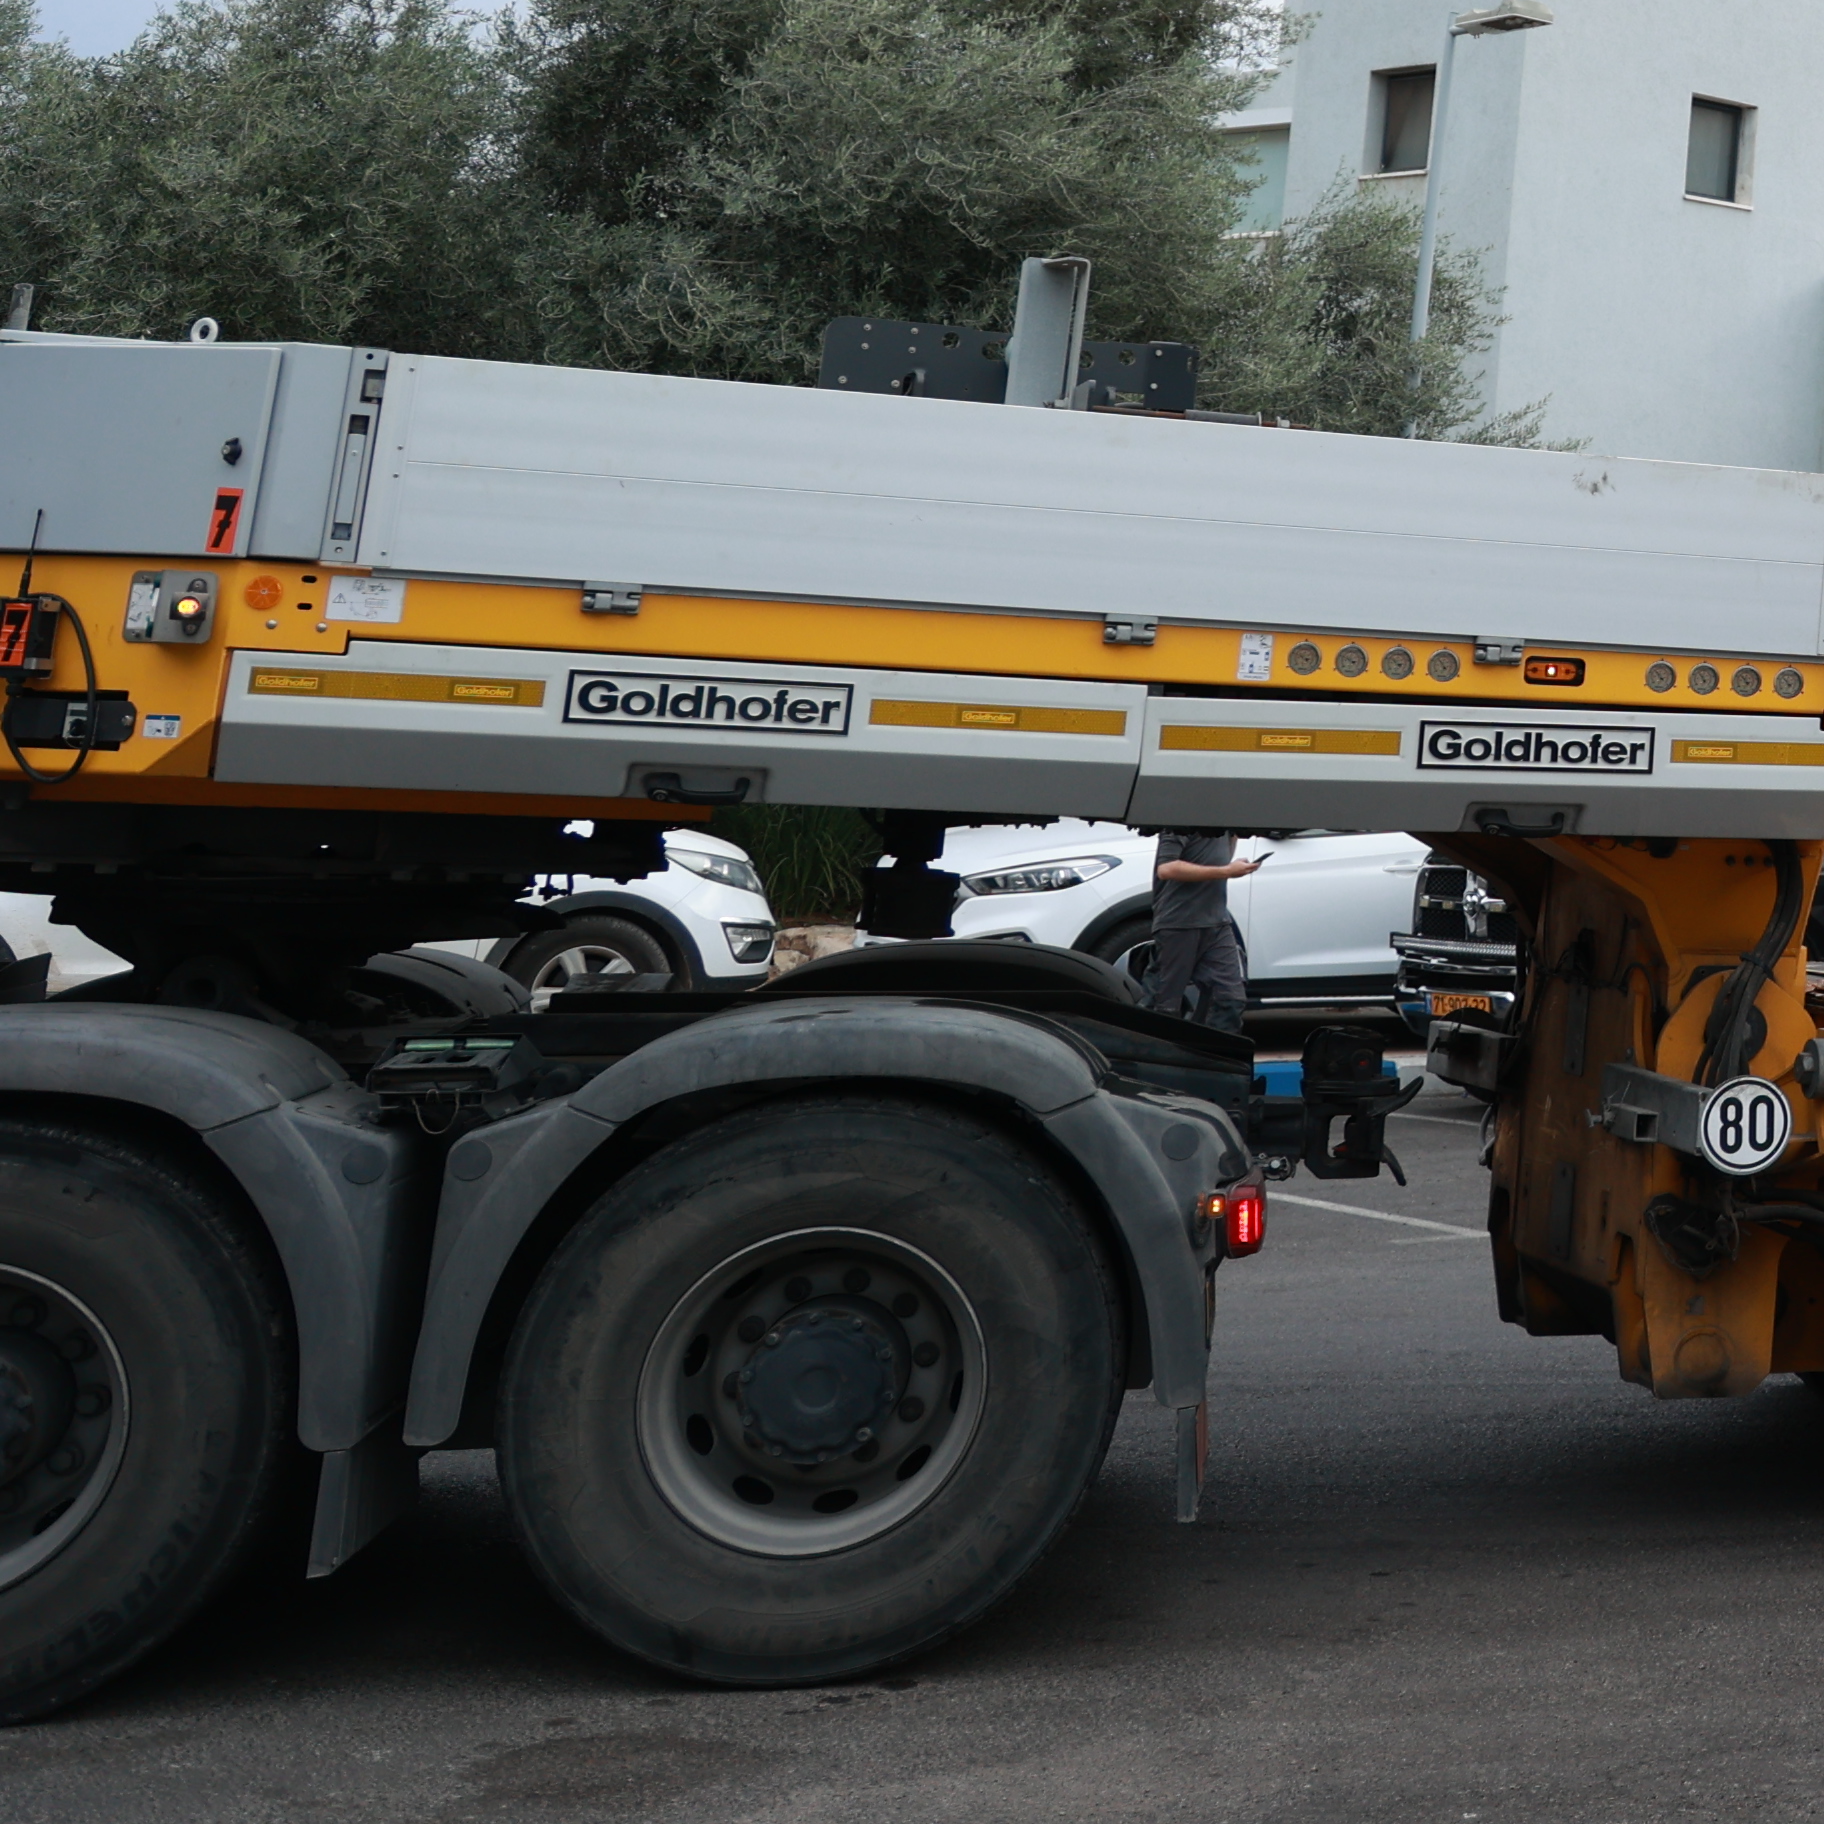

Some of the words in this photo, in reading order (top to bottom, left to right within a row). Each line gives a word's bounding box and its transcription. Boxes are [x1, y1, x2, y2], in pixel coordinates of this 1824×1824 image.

[258, 676, 316, 689] Goldhofer
[455, 686, 513, 698] Goldhofer
[577, 681, 841, 726] Goldhofer
[1428, 729, 1646, 765] Goldhofer
[1719, 1096, 1775, 1154] 80
